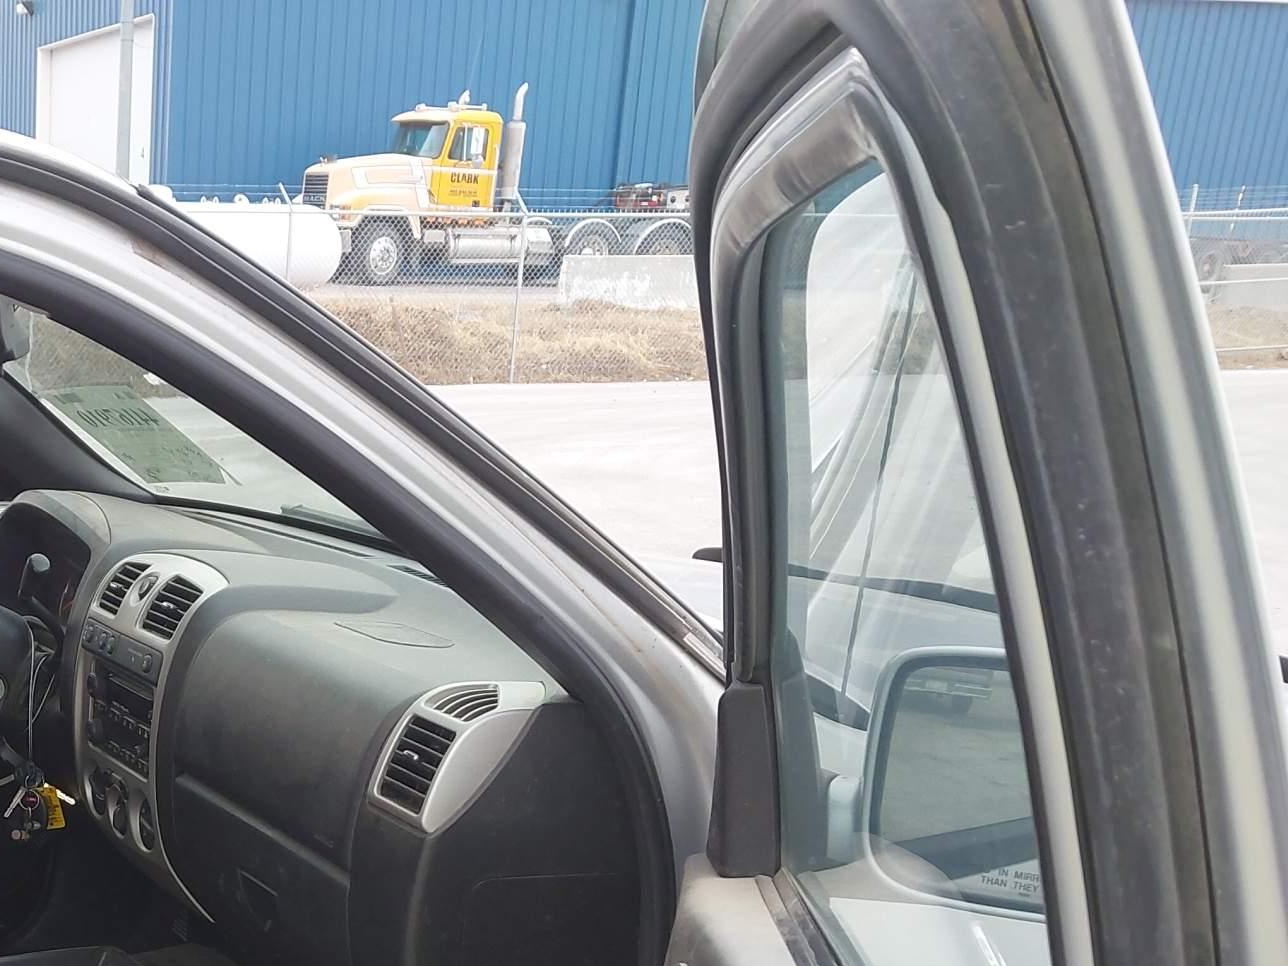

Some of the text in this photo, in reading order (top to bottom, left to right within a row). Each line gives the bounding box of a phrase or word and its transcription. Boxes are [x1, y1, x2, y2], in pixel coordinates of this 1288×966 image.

[450, 172, 480, 184] CLARK
[981, 875, 1040, 893] THAN THEY
